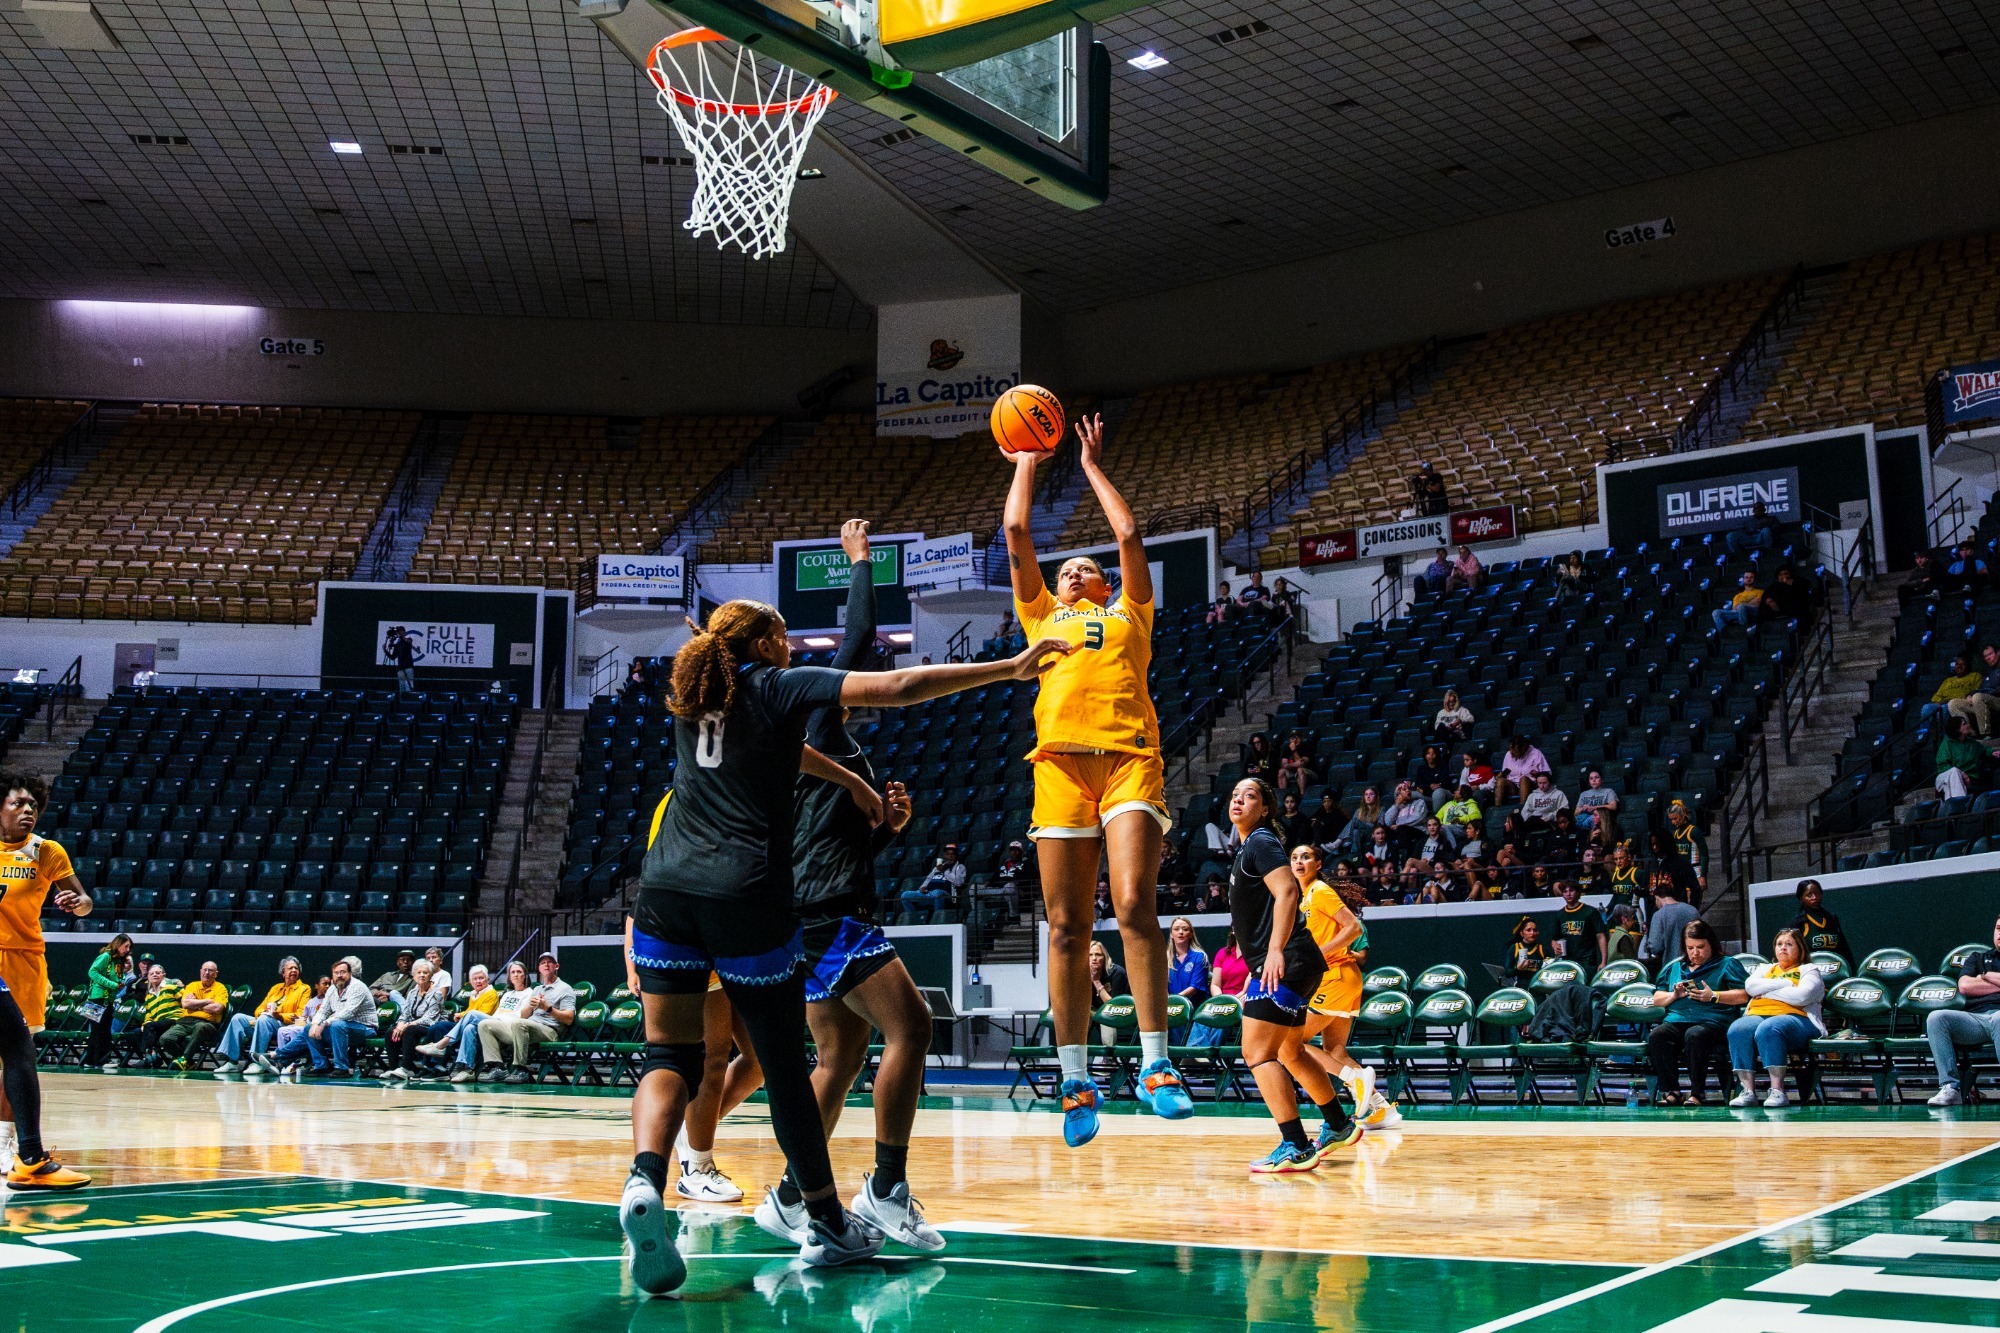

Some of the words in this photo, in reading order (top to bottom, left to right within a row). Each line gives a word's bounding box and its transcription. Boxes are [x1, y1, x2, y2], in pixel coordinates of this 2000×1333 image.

[1605, 229, 1656, 247] Gate
[1662, 217, 1676, 235] 4
[260, 338, 306, 353] Gate
[313, 339, 325, 354] 5
[877, 382, 910, 405] La
[918, 372, 1020, 406] Capitol
[876, 415, 931, 428] FEDERAL
[934, 412, 979, 425] CREDIT
[1028, 404, 1056, 438] NCAA
[1666, 478, 1788, 515] DUFRENE
[1668, 512, 1723, 527] BUILDING
[1724, 503, 1789, 519] MATEIALS
[1364, 522, 1442, 546] CONCESSIONS
[803, 551, 887, 567] COURTRD
[907, 552, 922, 565] La
[924, 542, 969, 563] Capitol
[602, 563, 620, 576] La
[624, 563, 679, 580] Capitol
[906, 569, 930, 577] FEDERAL
[427, 625, 475, 640] FULL
[1084, 620, 1105, 652] 3
[442, 655, 474, 665] TITLE
[696, 709, 725, 769] 0
[1, 866, 37, 880] LIONS
[1867, 958, 1911, 972] Lions
[1366, 974, 1402, 987] Lions
[1421, 973, 1458, 986] Lions
[1538, 970, 1577, 983] Lions
[1600, 969, 1640, 982] Lions
[1834, 987, 1882, 1003] Lions
[1908, 987, 1957, 1001] Lions
[1203, 1002, 1238, 1016] Lions
[1366, 1001, 1404, 1014] Lions
[1425, 999, 1466, 1013] Lions
[1486, 999, 1527, 1013] Lions
